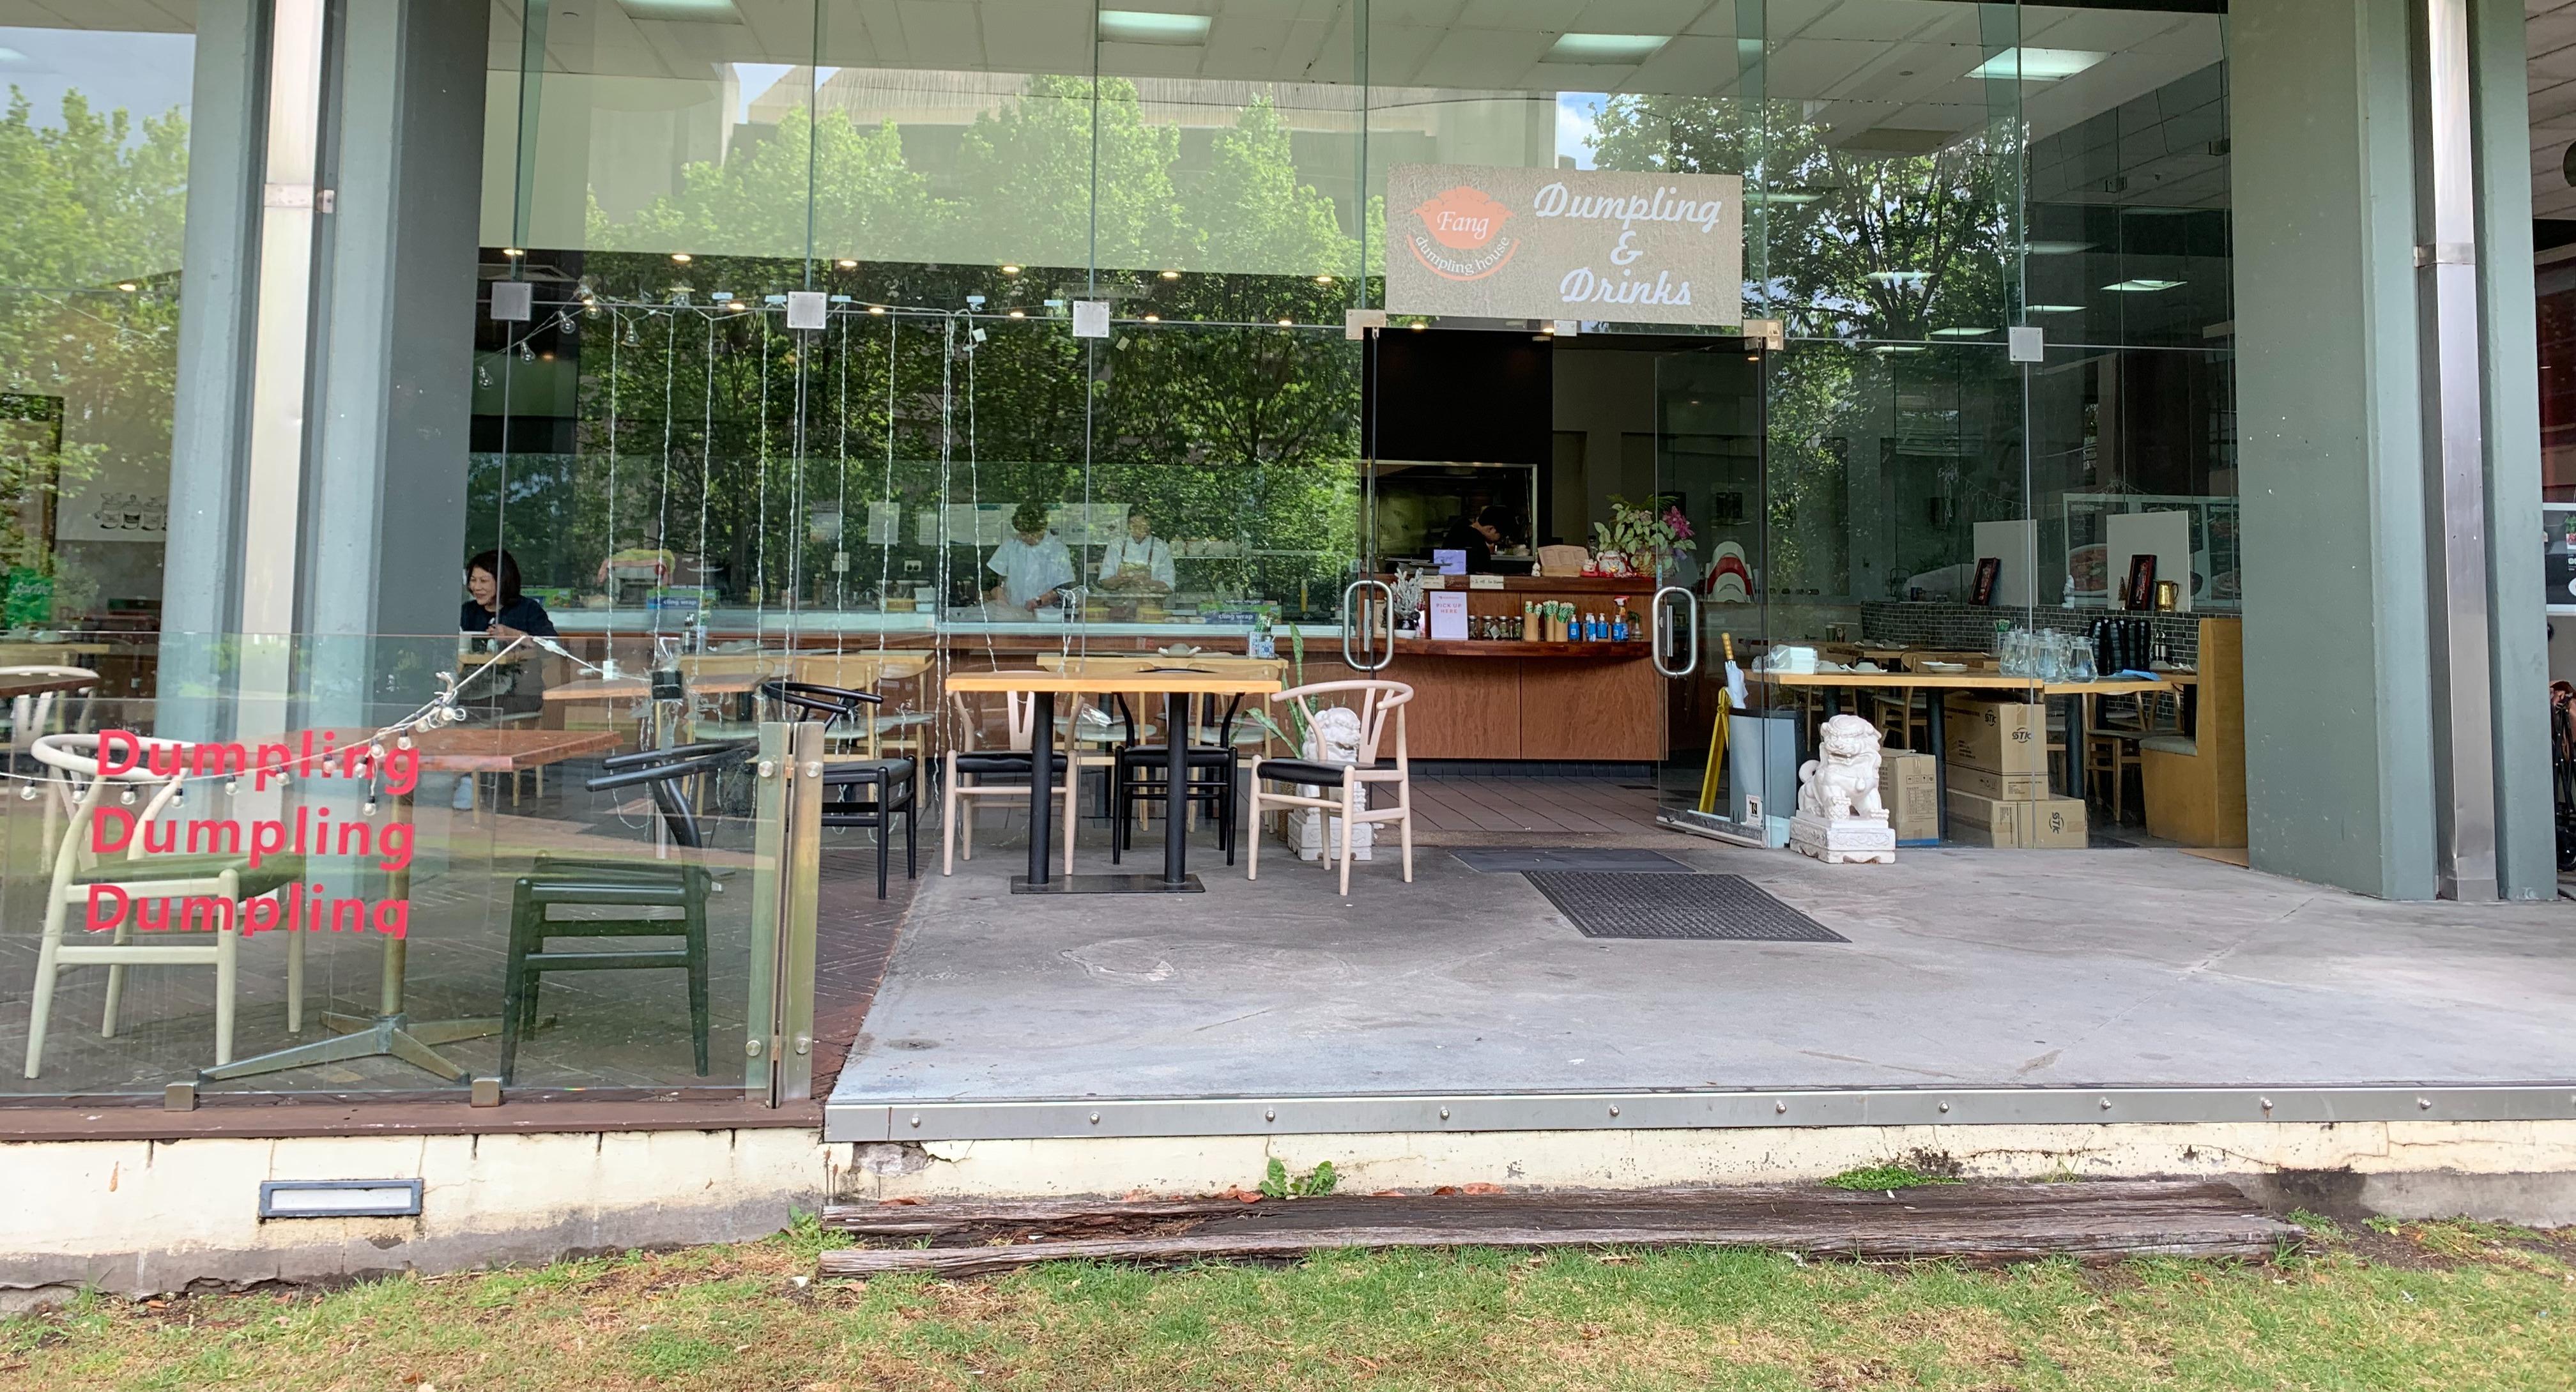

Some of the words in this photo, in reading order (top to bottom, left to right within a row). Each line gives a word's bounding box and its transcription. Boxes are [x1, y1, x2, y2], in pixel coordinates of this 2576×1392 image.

[1437, 211, 1489, 240] Fang
[1534, 181, 1722, 233] Dumpling
[1416, 236, 1474, 275] dumpling
[1475, 237, 1510, 270] house
[1610, 230, 1643, 265] &
[1559, 266, 1691, 305] Drinks
[96, 729, 419, 795] Dumpling
[91, 806, 414, 871] Dumpling
[85, 883, 410, 940] Dumpling
